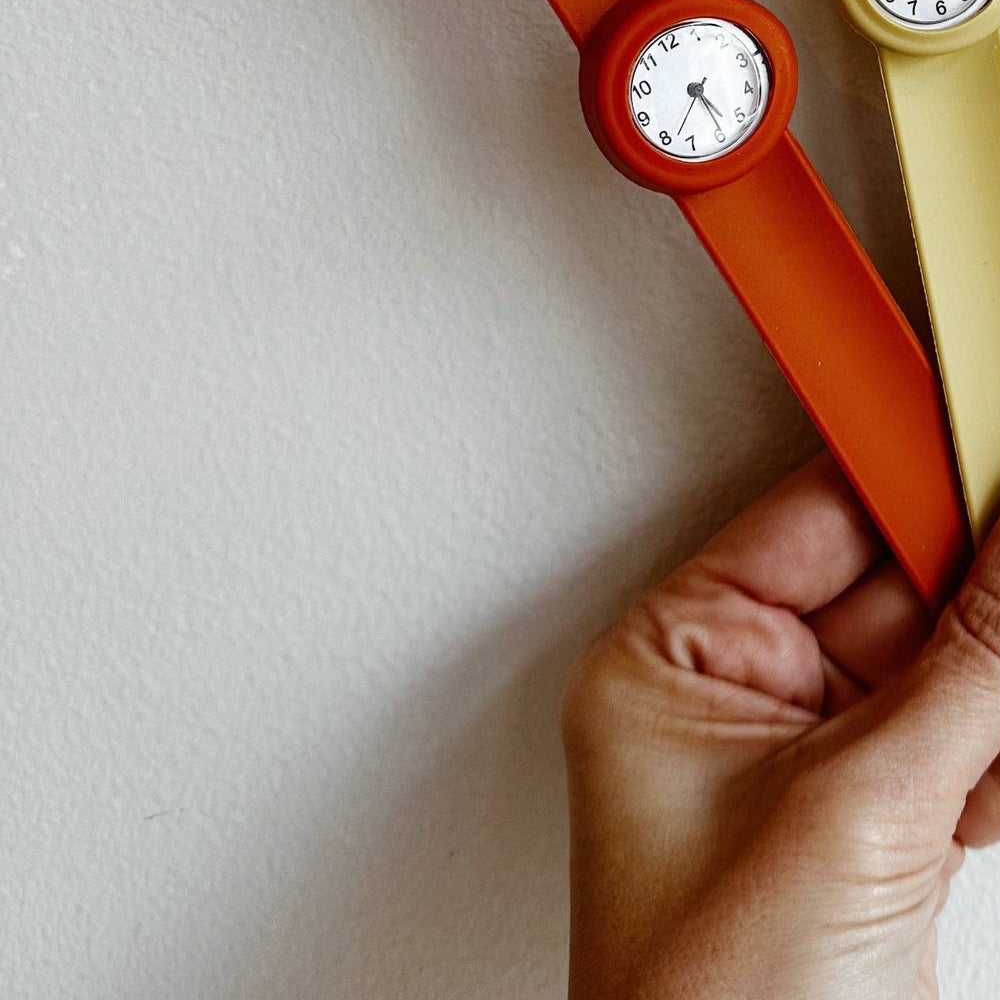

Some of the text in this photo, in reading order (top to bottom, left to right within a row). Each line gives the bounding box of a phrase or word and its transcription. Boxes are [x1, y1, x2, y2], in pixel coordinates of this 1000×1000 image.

[908, 0, 918, 15] 7
[936, 0, 946, 15] 6
[658, 34, 679, 52] 12
[716, 34, 729, 49] 2
[640, 53, 657, 71] 11
[736, 53, 748, 68] 3
[632, 80, 651, 99] 10
[744, 81, 754, 94] 4
[638, 112, 650, 126] 9
[734, 107, 745, 122] 5
[659, 131, 672, 145] 8
[685, 135, 696, 151] 7
[714, 128, 726, 143] 6
